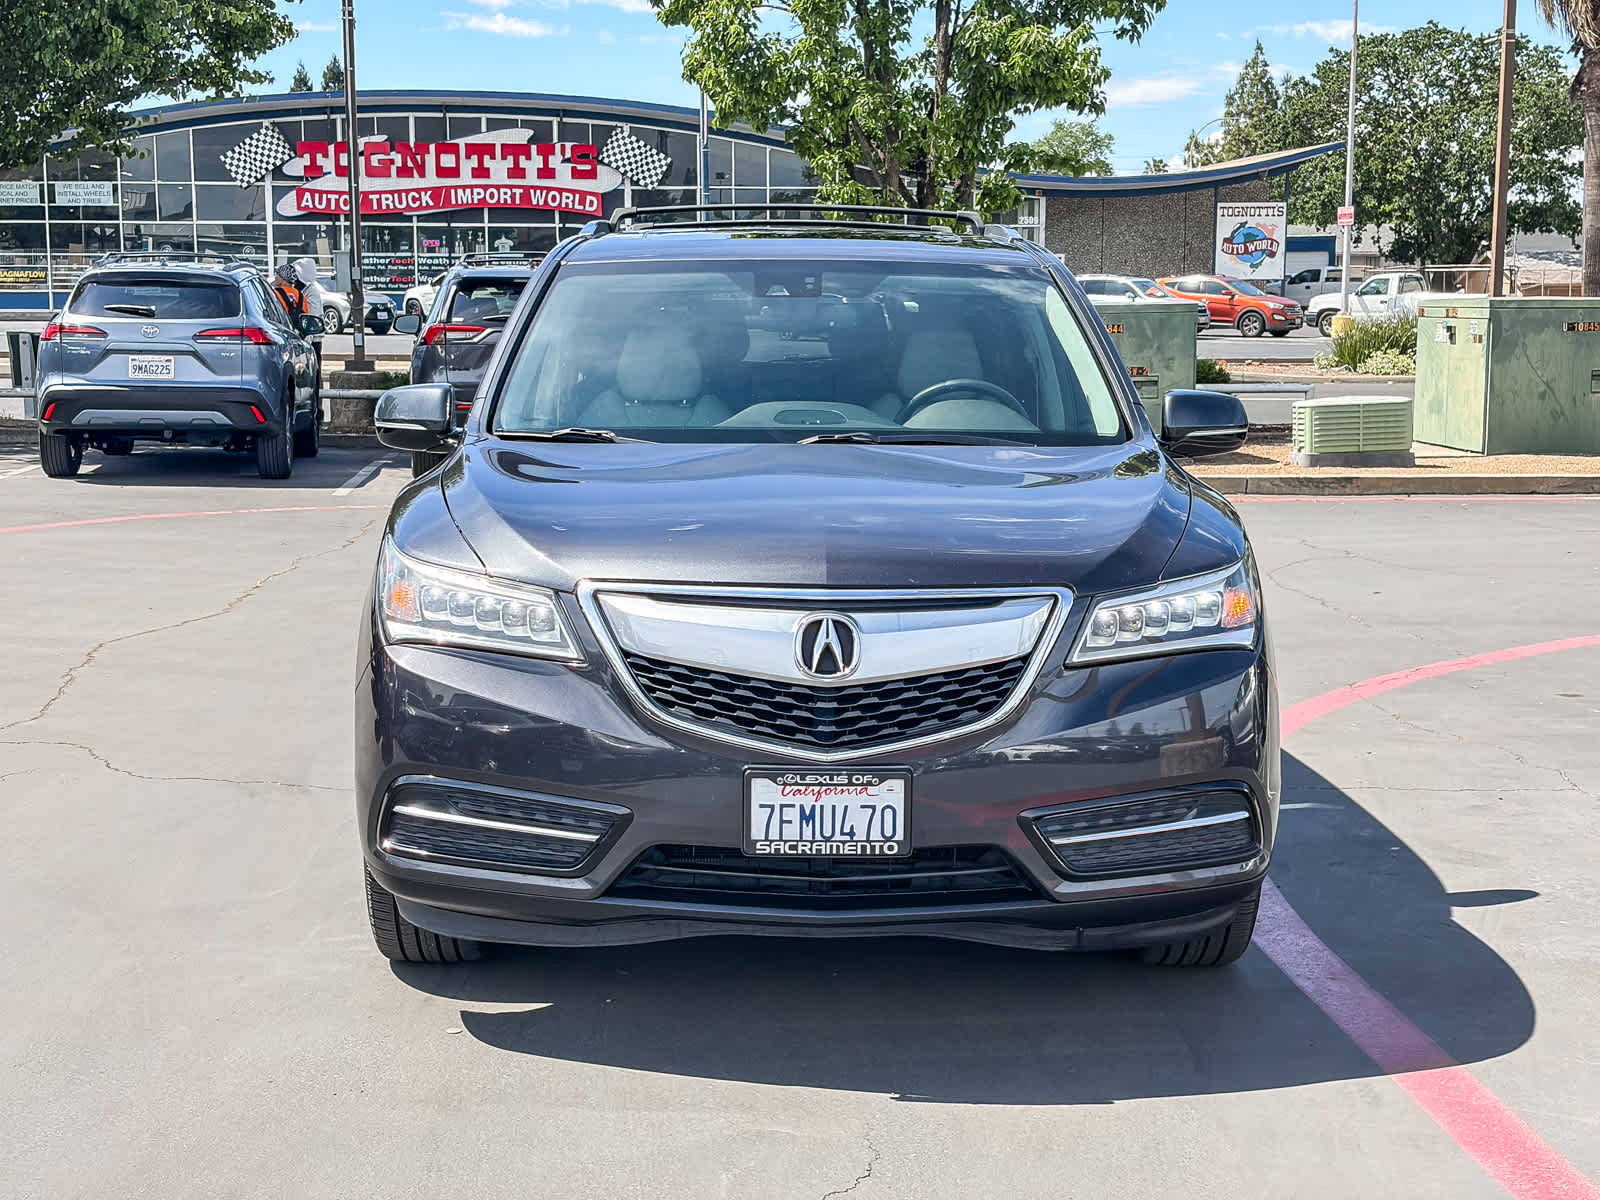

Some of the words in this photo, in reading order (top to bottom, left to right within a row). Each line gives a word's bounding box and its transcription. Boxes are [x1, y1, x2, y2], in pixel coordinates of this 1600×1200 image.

[296, 141, 598, 180] TOGNOTTI'S
[300, 191, 350, 210] AUTO
[368, 190, 434, 210] TRUCK
[451, 188, 524, 205] IMPORT
[530, 189, 598, 212] WORLD
[1219, 204, 1285, 217] TOGNOTTI'S
[1223, 242, 1245, 254] AUTO
[1246, 240, 1278, 253] WORLD
[132, 364, 171, 375] 9MAG225
[796, 775, 849, 784] LEXUS
[852, 775, 873, 784] OF
[781, 785, 880, 803] California
[758, 803, 898, 841] 7FMU470
[755, 841, 899, 855] SACRAMENTO
